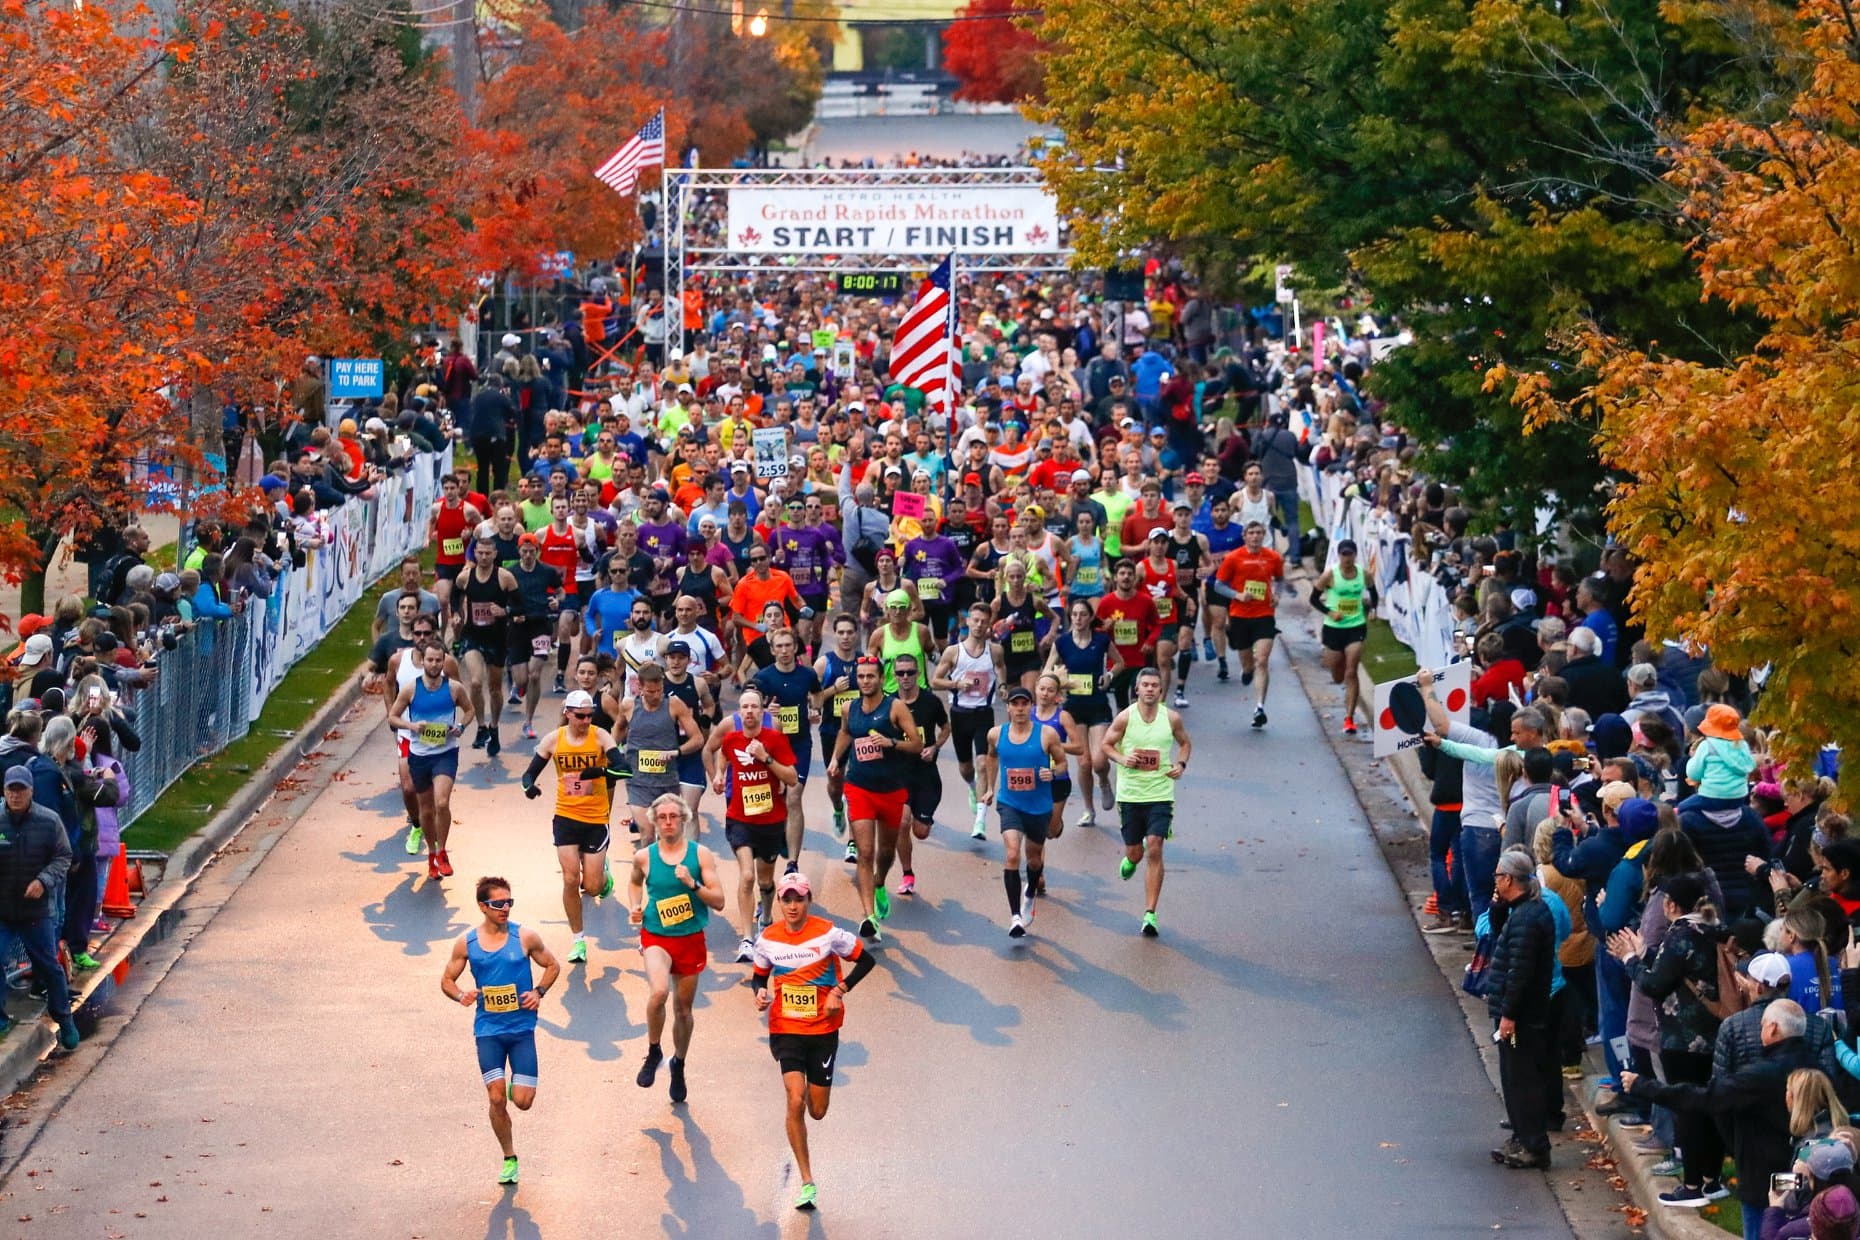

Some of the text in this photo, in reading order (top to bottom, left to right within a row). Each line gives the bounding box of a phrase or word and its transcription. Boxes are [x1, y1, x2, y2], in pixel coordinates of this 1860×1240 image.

[824, 192, 961, 201] METRO HEALTH
[761, 203, 1024, 222] Grand Rapids Marathon
[773, 225, 1014, 247] START / FINISH
[336, 362, 379, 374] PAY HERE
[339, 375, 376, 386] TO PARK
[758, 464, 786, 477] 2:59
[778, 713, 798, 723] 0003
[557, 755, 598, 769] FLINT
[574, 782, 581, 790] 5
[1010, 776, 1032, 785] 598
[660, 903, 691, 919] 10002
[774, 952, 814, 961] World Vision
[485, 993, 516, 1006] 11885
[783, 993, 815, 1006] 11391
